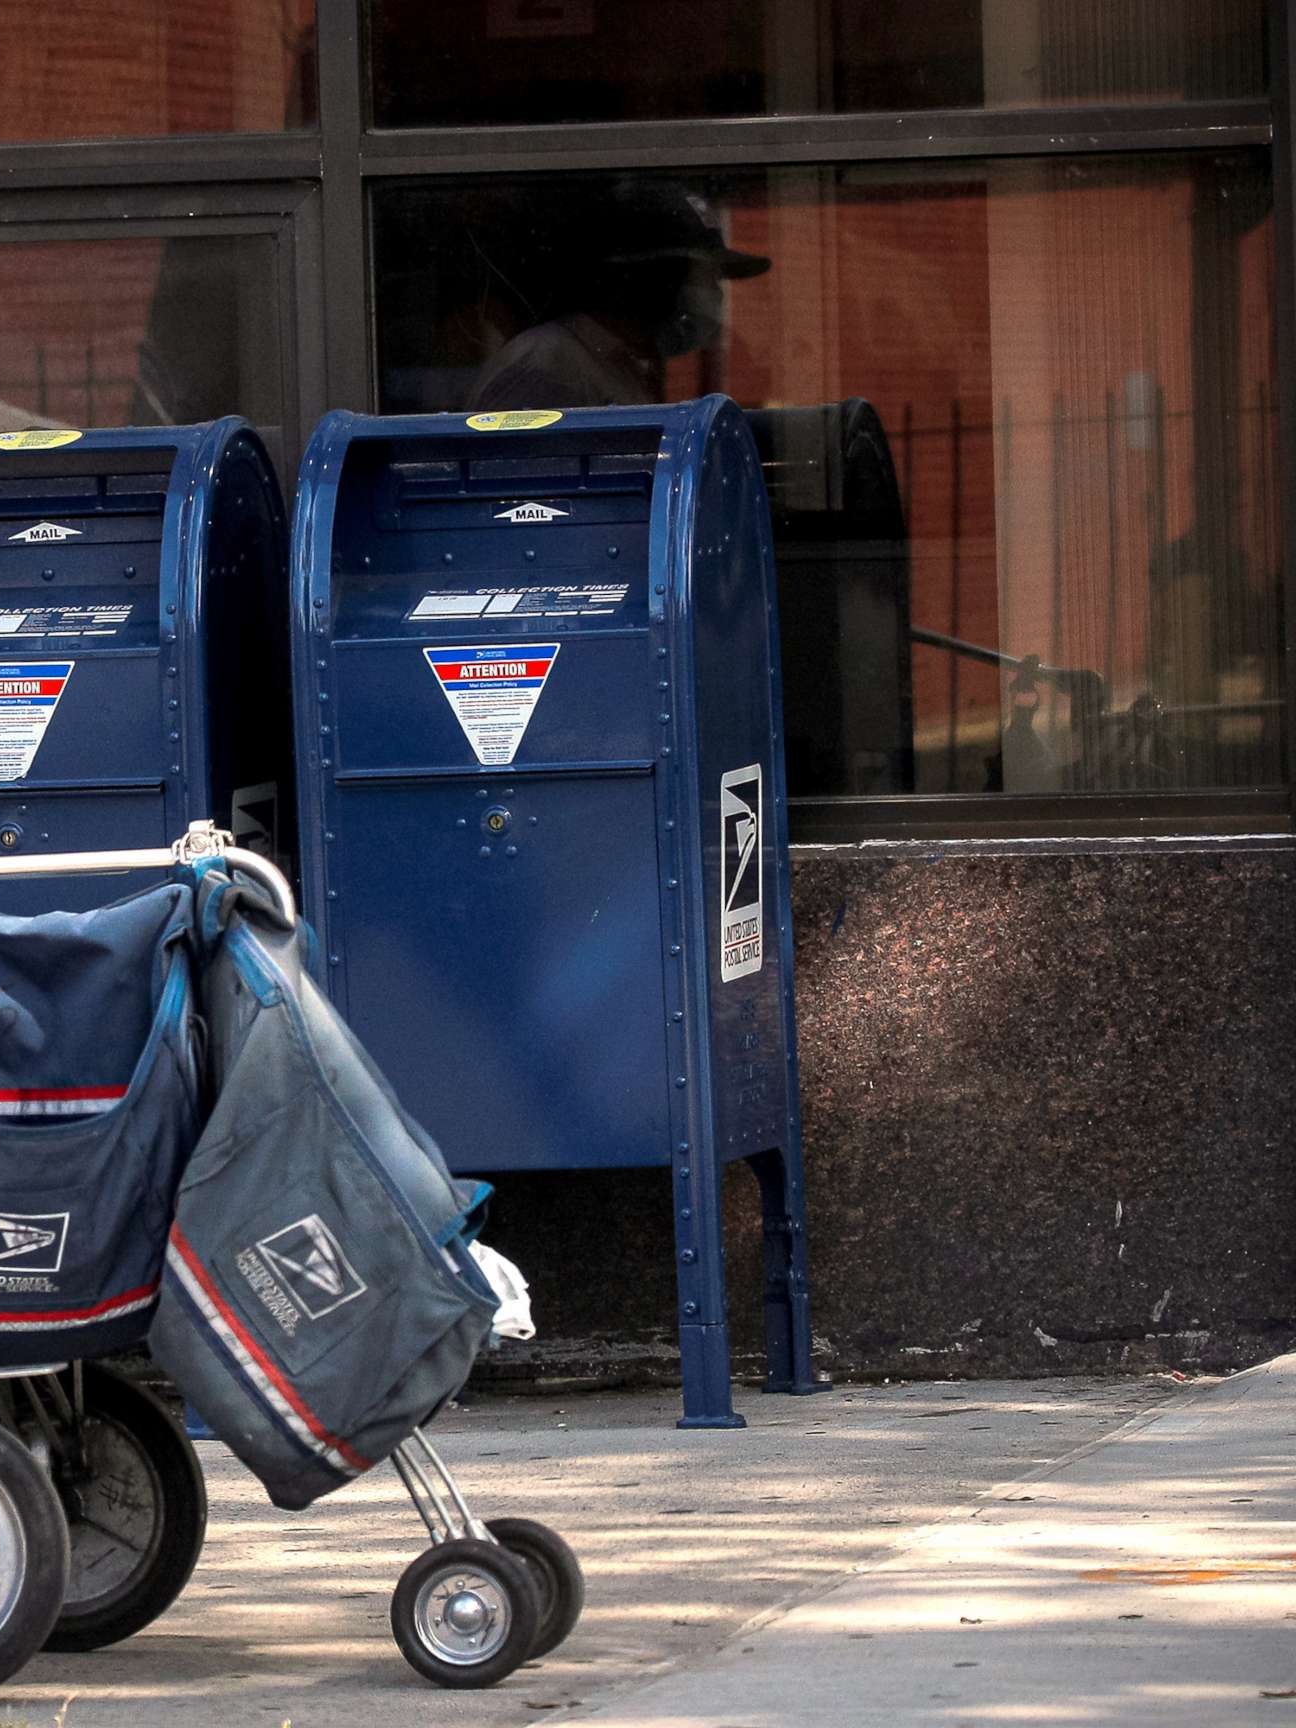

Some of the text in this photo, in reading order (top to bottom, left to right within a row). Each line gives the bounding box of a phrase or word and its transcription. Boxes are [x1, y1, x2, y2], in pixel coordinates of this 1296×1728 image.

[515, 509, 548, 520] MAIL
[29, 528, 62, 540] MAIL
[475, 585, 577, 594] COLLECTION
[581, 583, 630, 591] TIMES
[86, 604, 133, 612] TIMES
[460, 663, 527, 677] ATTENTION
[724, 916, 760, 944] UNITED STATES
[724, 940, 760, 968] POSTAL SERVICE
[7, 1276, 50, 1286] STATES
